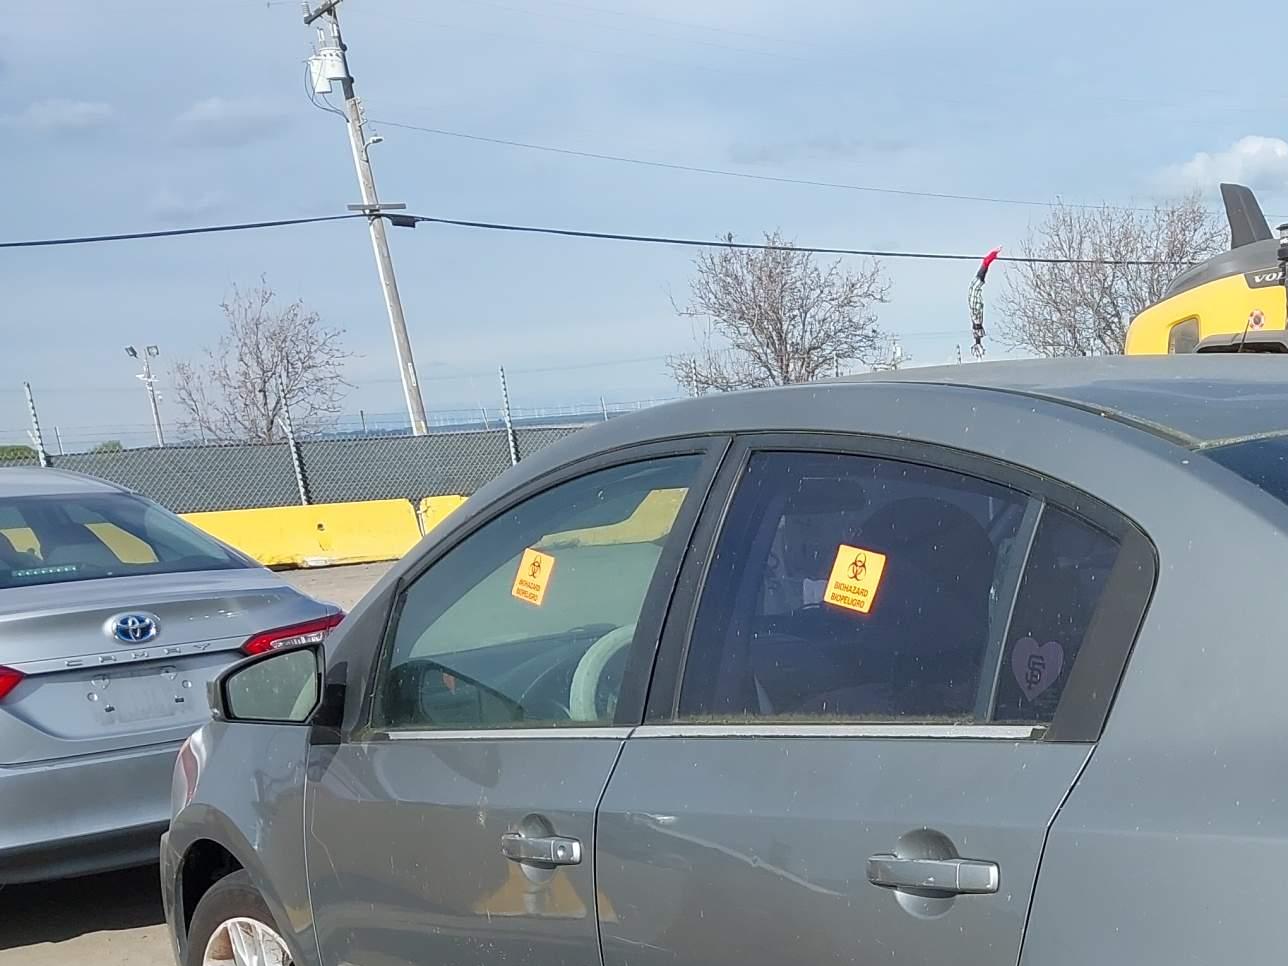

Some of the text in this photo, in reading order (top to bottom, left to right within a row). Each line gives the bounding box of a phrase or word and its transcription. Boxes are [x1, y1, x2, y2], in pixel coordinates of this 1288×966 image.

[834, 581, 869, 598] BIOHAZARD
[830, 592, 866, 609] BIOPELIGRO
[65, 642, 211, 667] CAMRY
